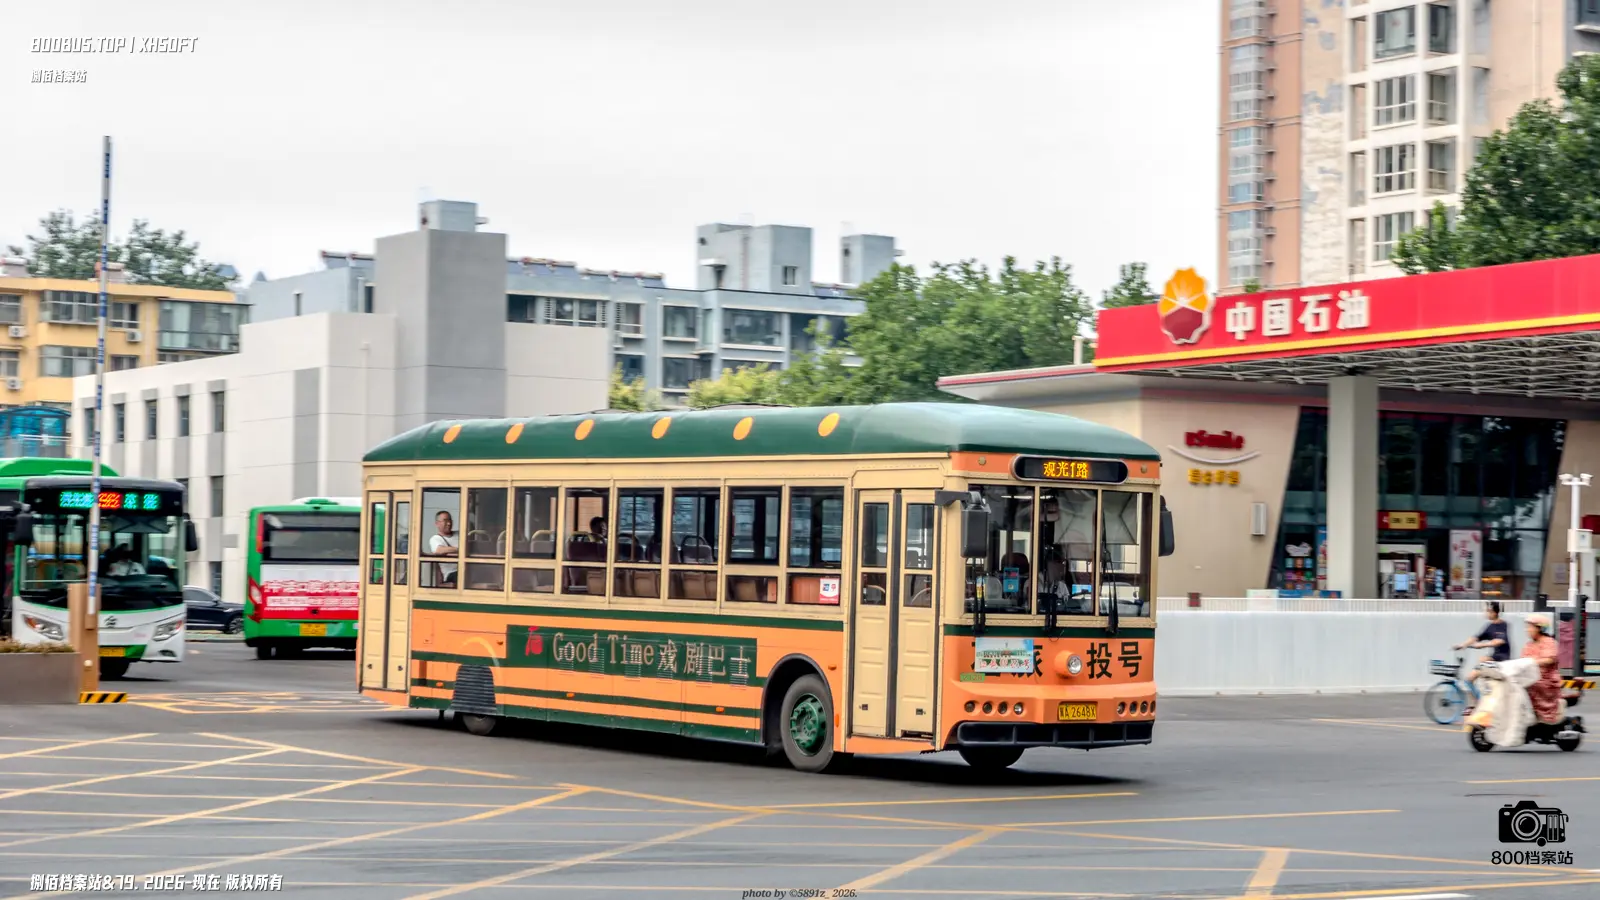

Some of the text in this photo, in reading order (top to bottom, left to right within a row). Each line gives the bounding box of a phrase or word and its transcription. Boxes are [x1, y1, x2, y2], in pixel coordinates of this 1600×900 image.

[1225, 289, 1370, 341] 中国石油
[1043, 461, 1089, 479] 观光1路
[552, 631, 600, 663] Good
[606, 633, 655, 665] Time
